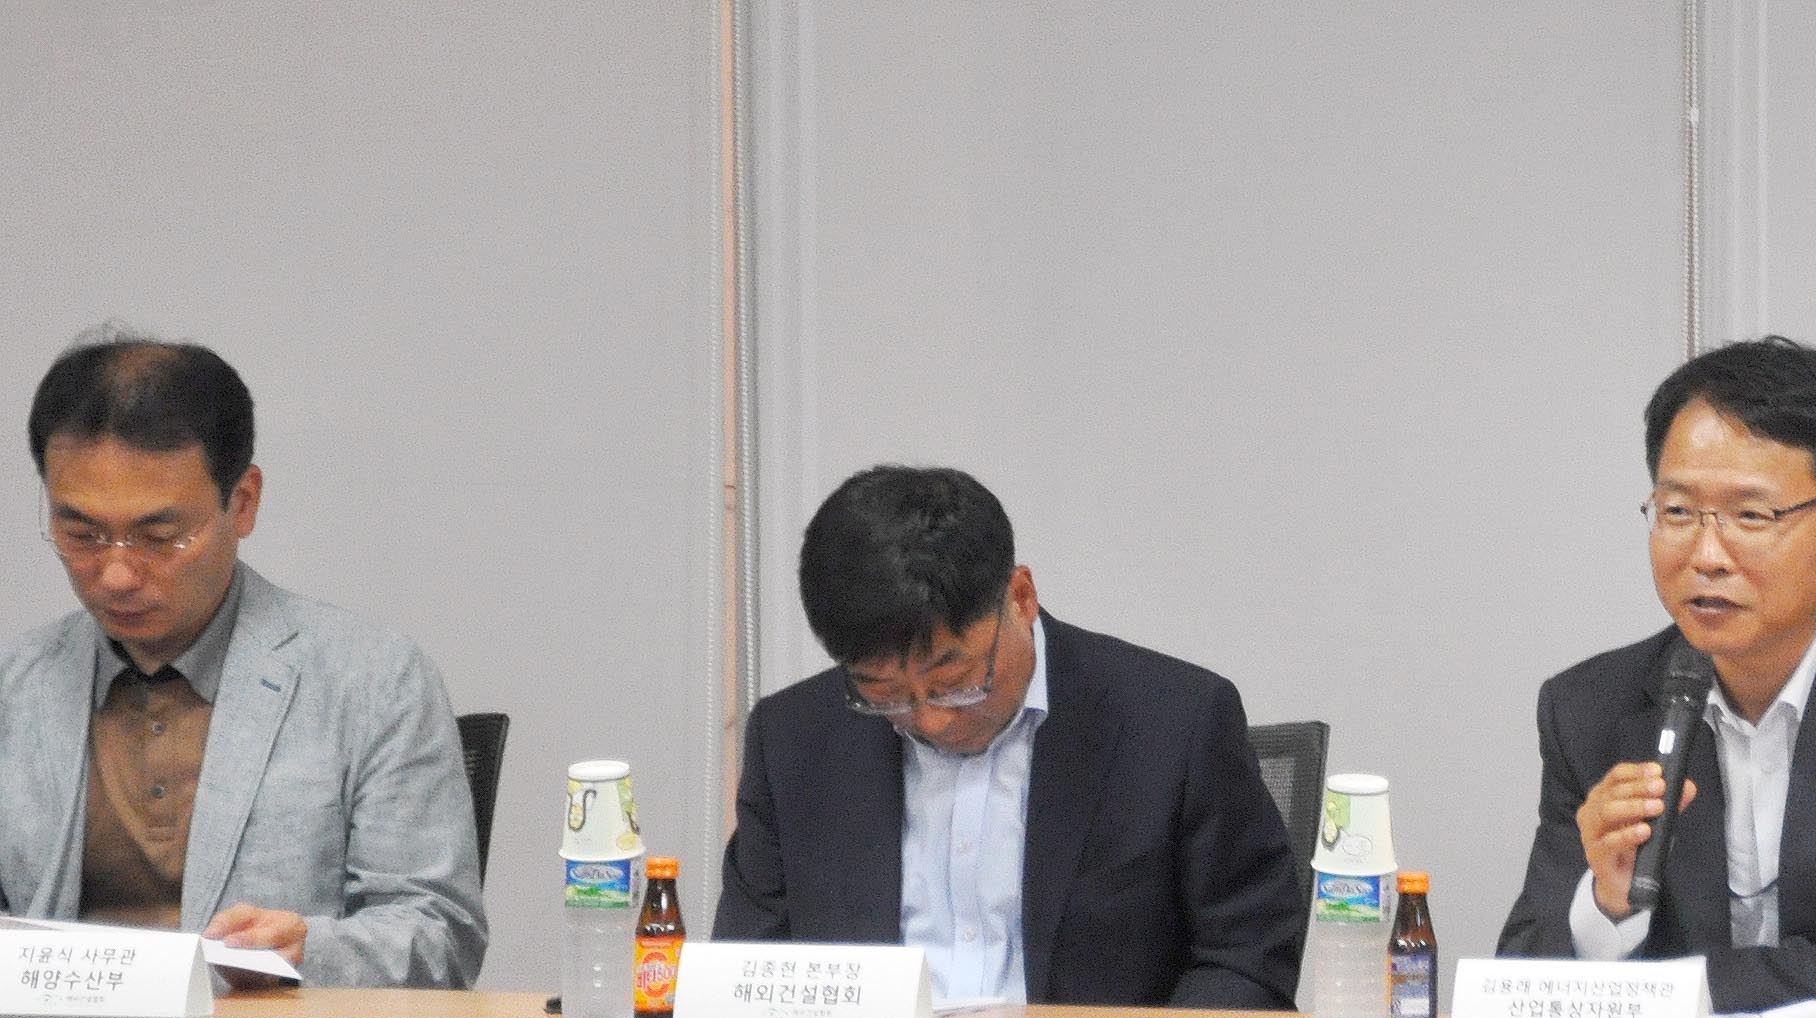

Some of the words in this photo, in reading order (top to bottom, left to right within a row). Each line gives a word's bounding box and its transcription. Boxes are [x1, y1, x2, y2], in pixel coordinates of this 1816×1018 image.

[18, 945, 74, 965] 지윤식
[81, 947, 137, 966] 사무관
[20, 969, 124, 991] 해양수산부
[806, 961, 862, 980] 본부장
[733, 982, 862, 1006] 해외건설협회
